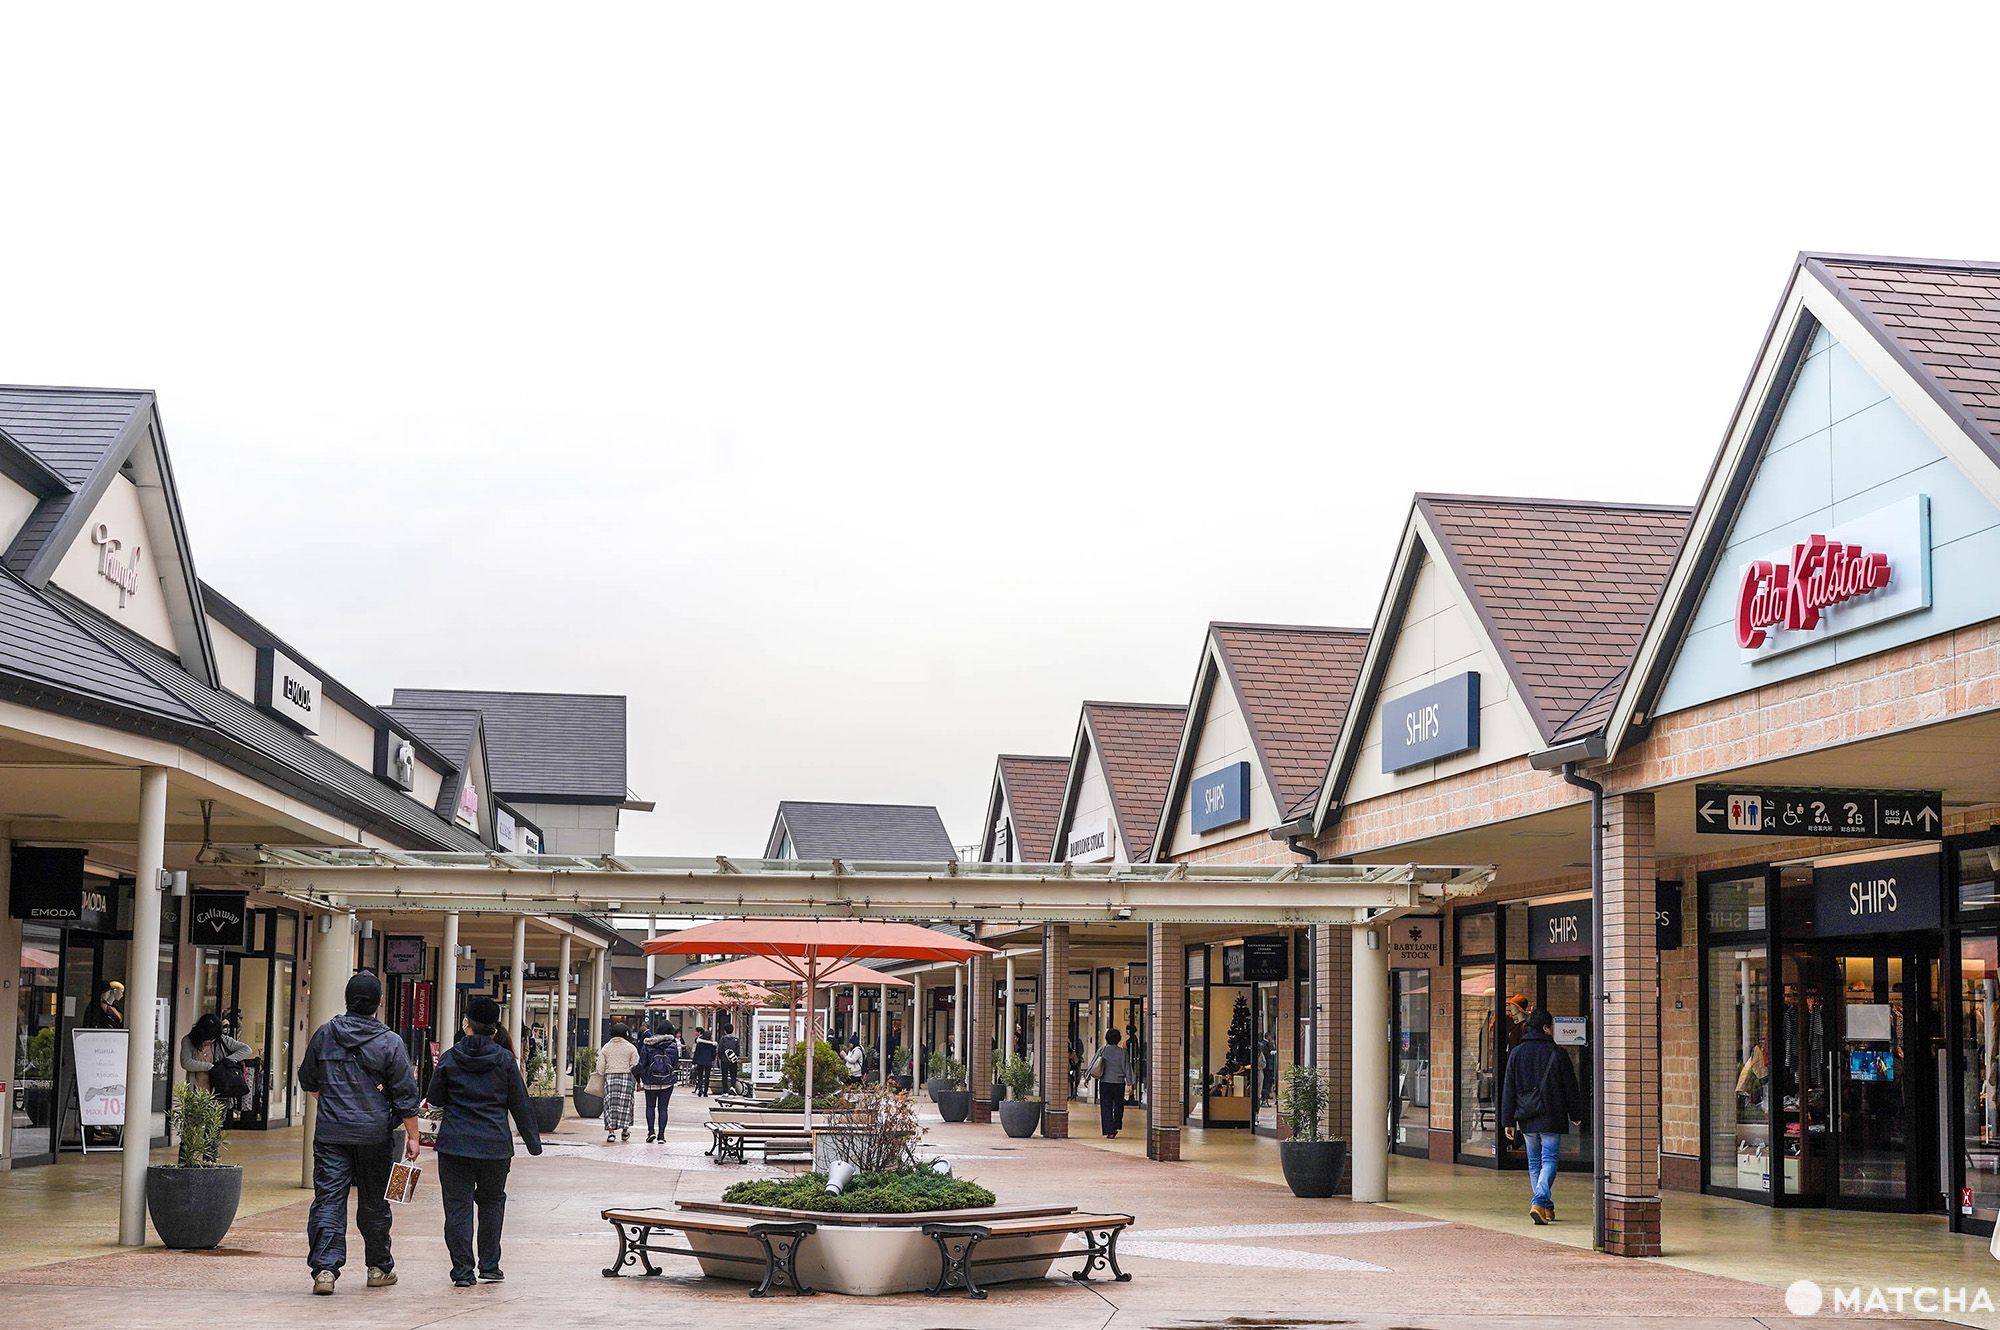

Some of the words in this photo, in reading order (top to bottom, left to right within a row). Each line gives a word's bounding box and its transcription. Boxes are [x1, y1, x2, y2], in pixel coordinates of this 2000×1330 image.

[1735, 560, 1789, 649] Cath
[1784, 534, 1891, 631] Kidston
[283, 676, 311, 711] EMODA
[1406, 703, 1439, 746] SHIPS
[1205, 783, 1225, 815] SHIPS
[31, 908, 77, 917] EMODA
[82, 891, 107, 913] MODA
[1849, 877, 1898, 916] SHIPS
[196, 908, 240, 925] Callaway
[1549, 915, 1578, 944] SHIPS
